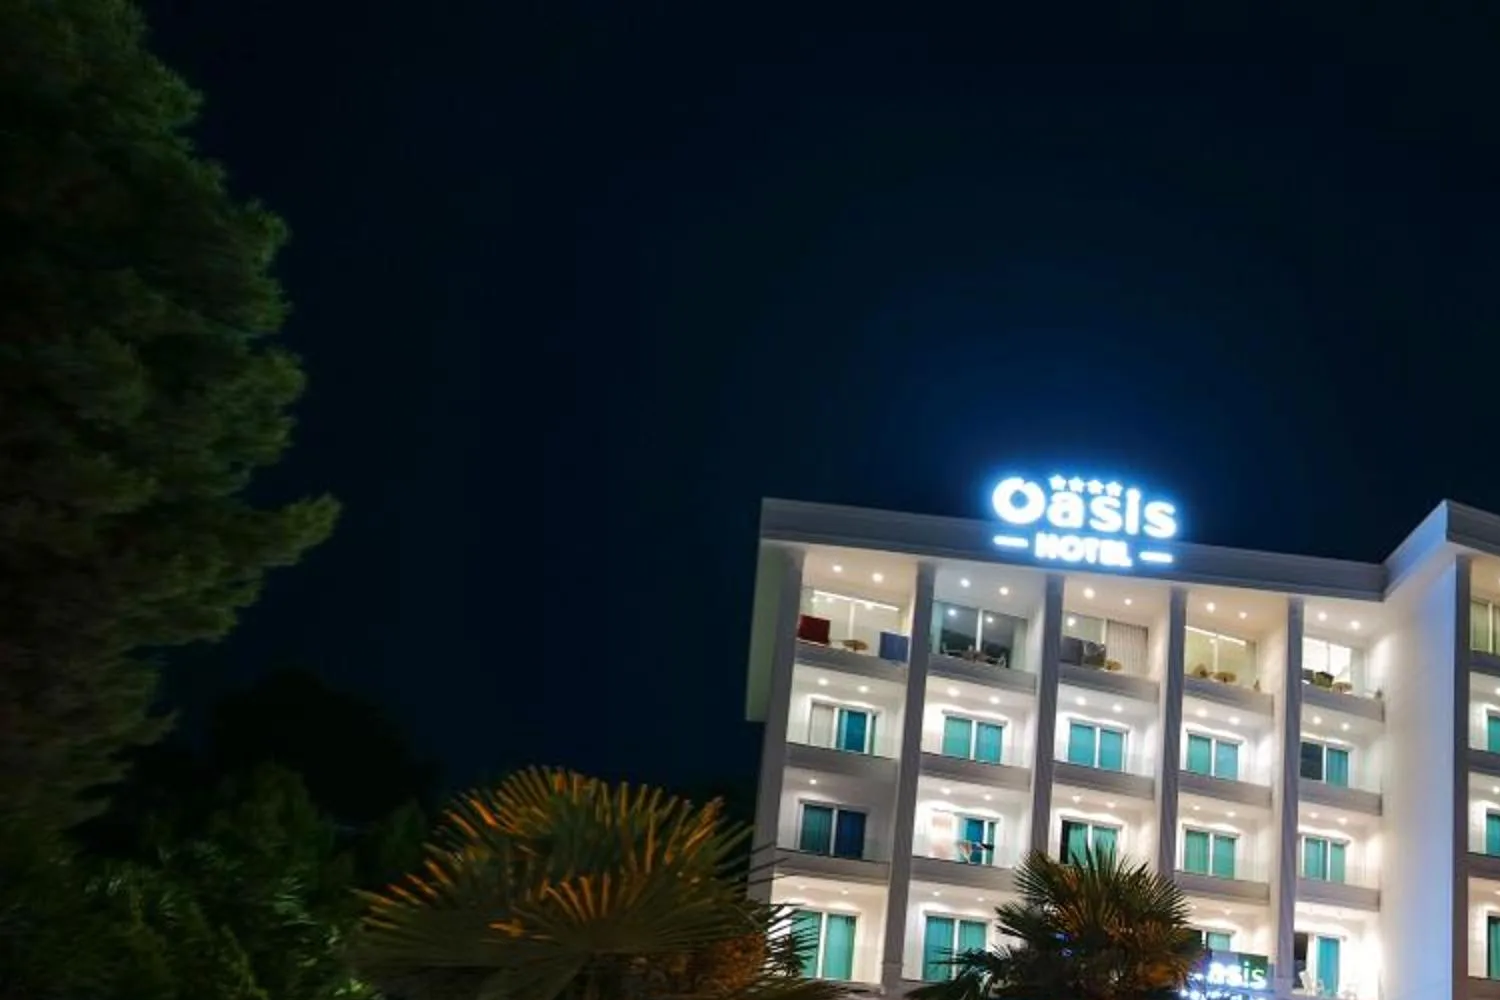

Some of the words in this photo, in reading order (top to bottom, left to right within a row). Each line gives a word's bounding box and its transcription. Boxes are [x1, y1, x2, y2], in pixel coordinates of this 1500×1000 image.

[992, 477, 1177, 538] Oasis
[1034, 532, 1133, 567] HOTEL
[1188, 961, 1269, 990] asis
